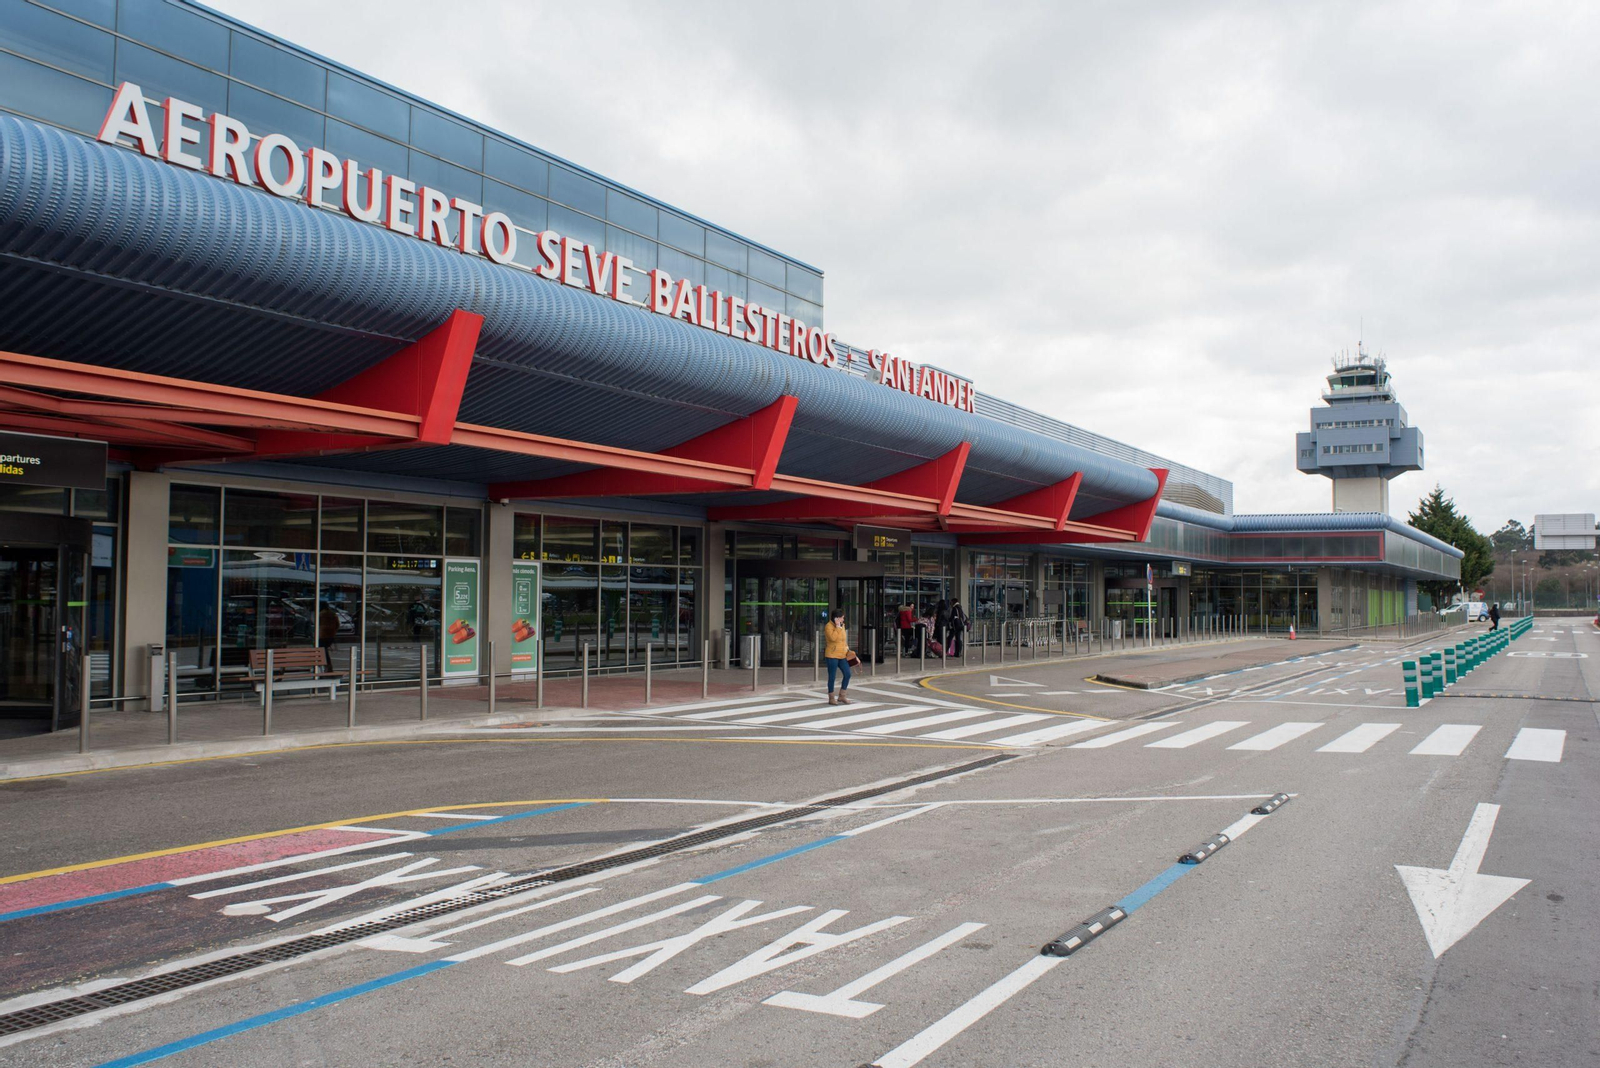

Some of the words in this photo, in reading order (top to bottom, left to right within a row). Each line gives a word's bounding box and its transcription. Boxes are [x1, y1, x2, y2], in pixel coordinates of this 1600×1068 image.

[96, 81, 518, 265] AEROPUERTO
[532, 230, 634, 304] SEVE
[650, 269, 838, 368] BALLESTEROS
[868, 349, 976, 414] SANTANDER
[0, 454, 41, 465] partures
[504, 895, 989, 1019] TAXI
